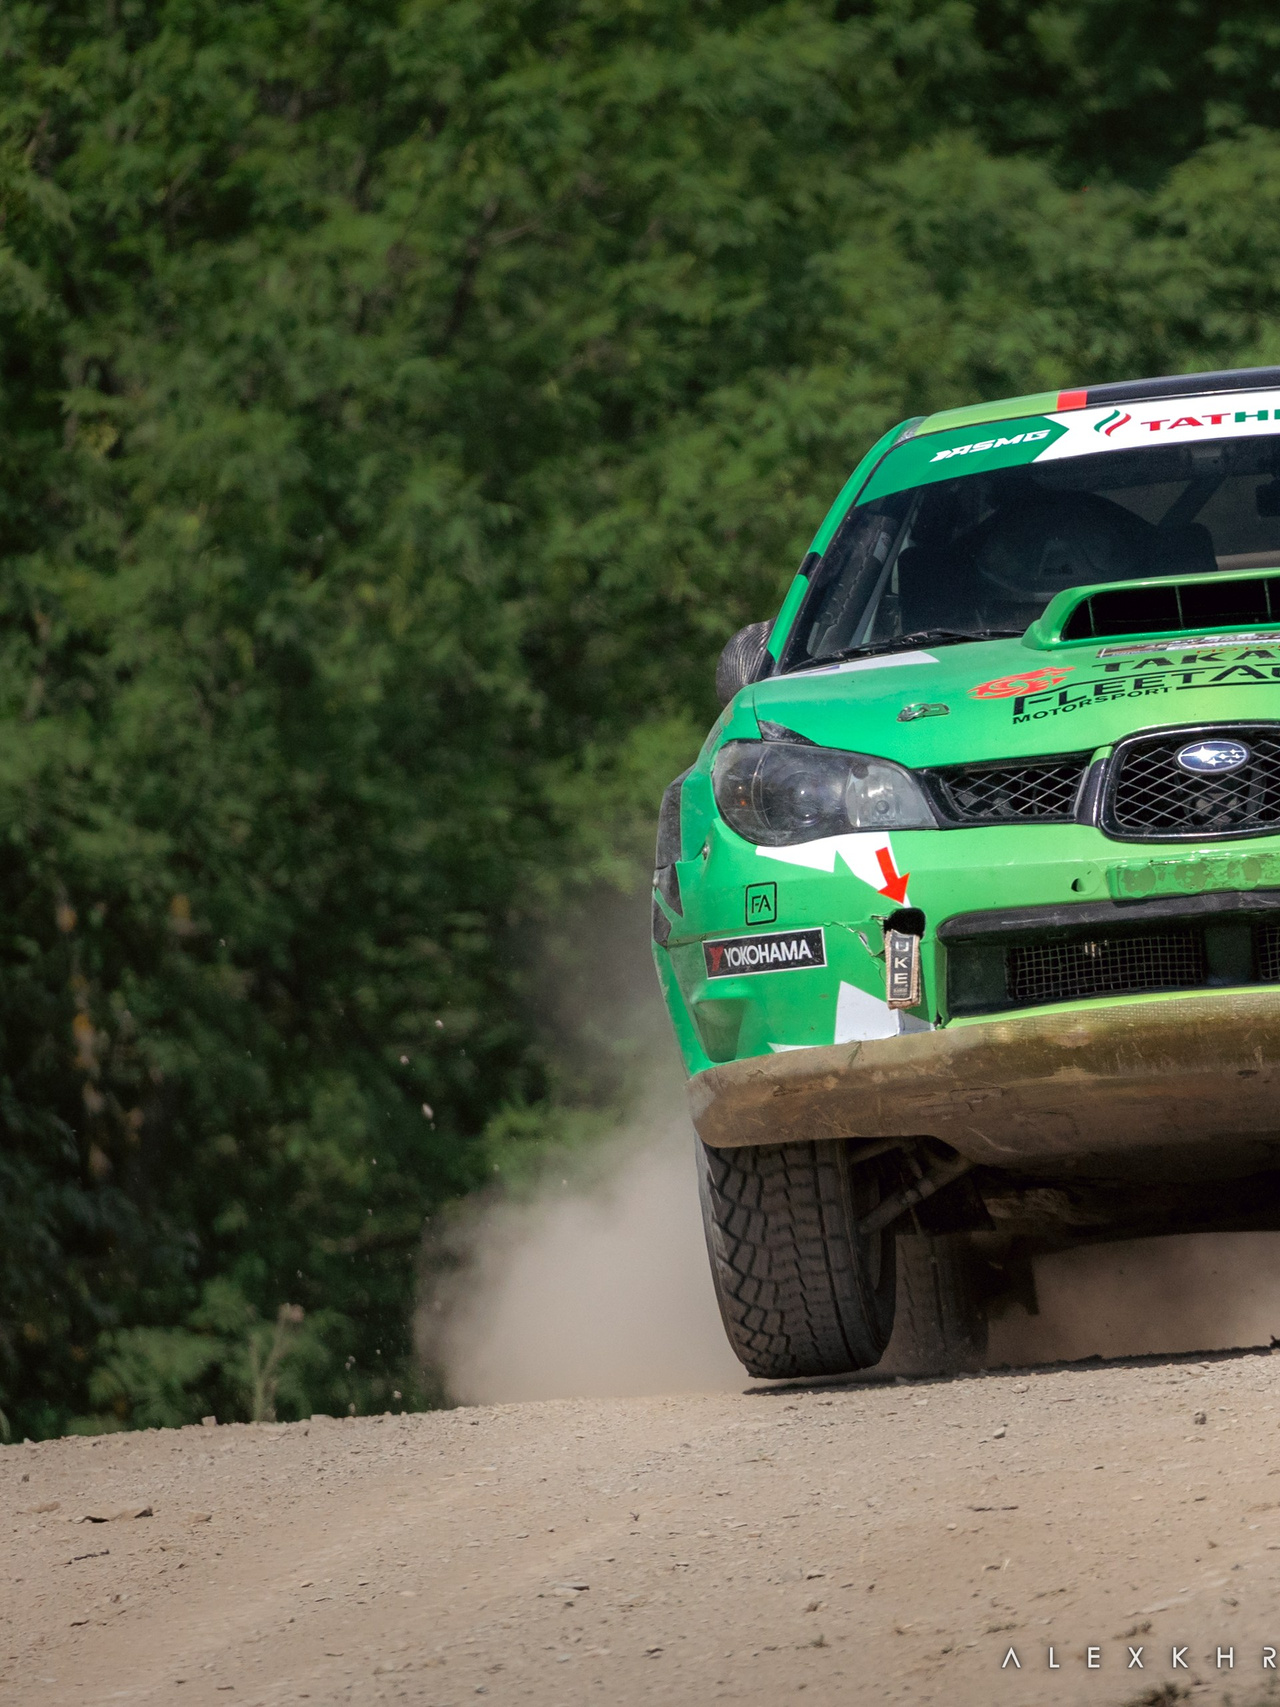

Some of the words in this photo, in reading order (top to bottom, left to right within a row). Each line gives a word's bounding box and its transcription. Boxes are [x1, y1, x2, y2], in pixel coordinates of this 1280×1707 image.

[1012, 686, 1173, 725] MOTORSPORT
[751, 894, 772, 914] FA
[723, 938, 813, 968] YOKOHAMA
[893, 935, 910, 985] UKE
